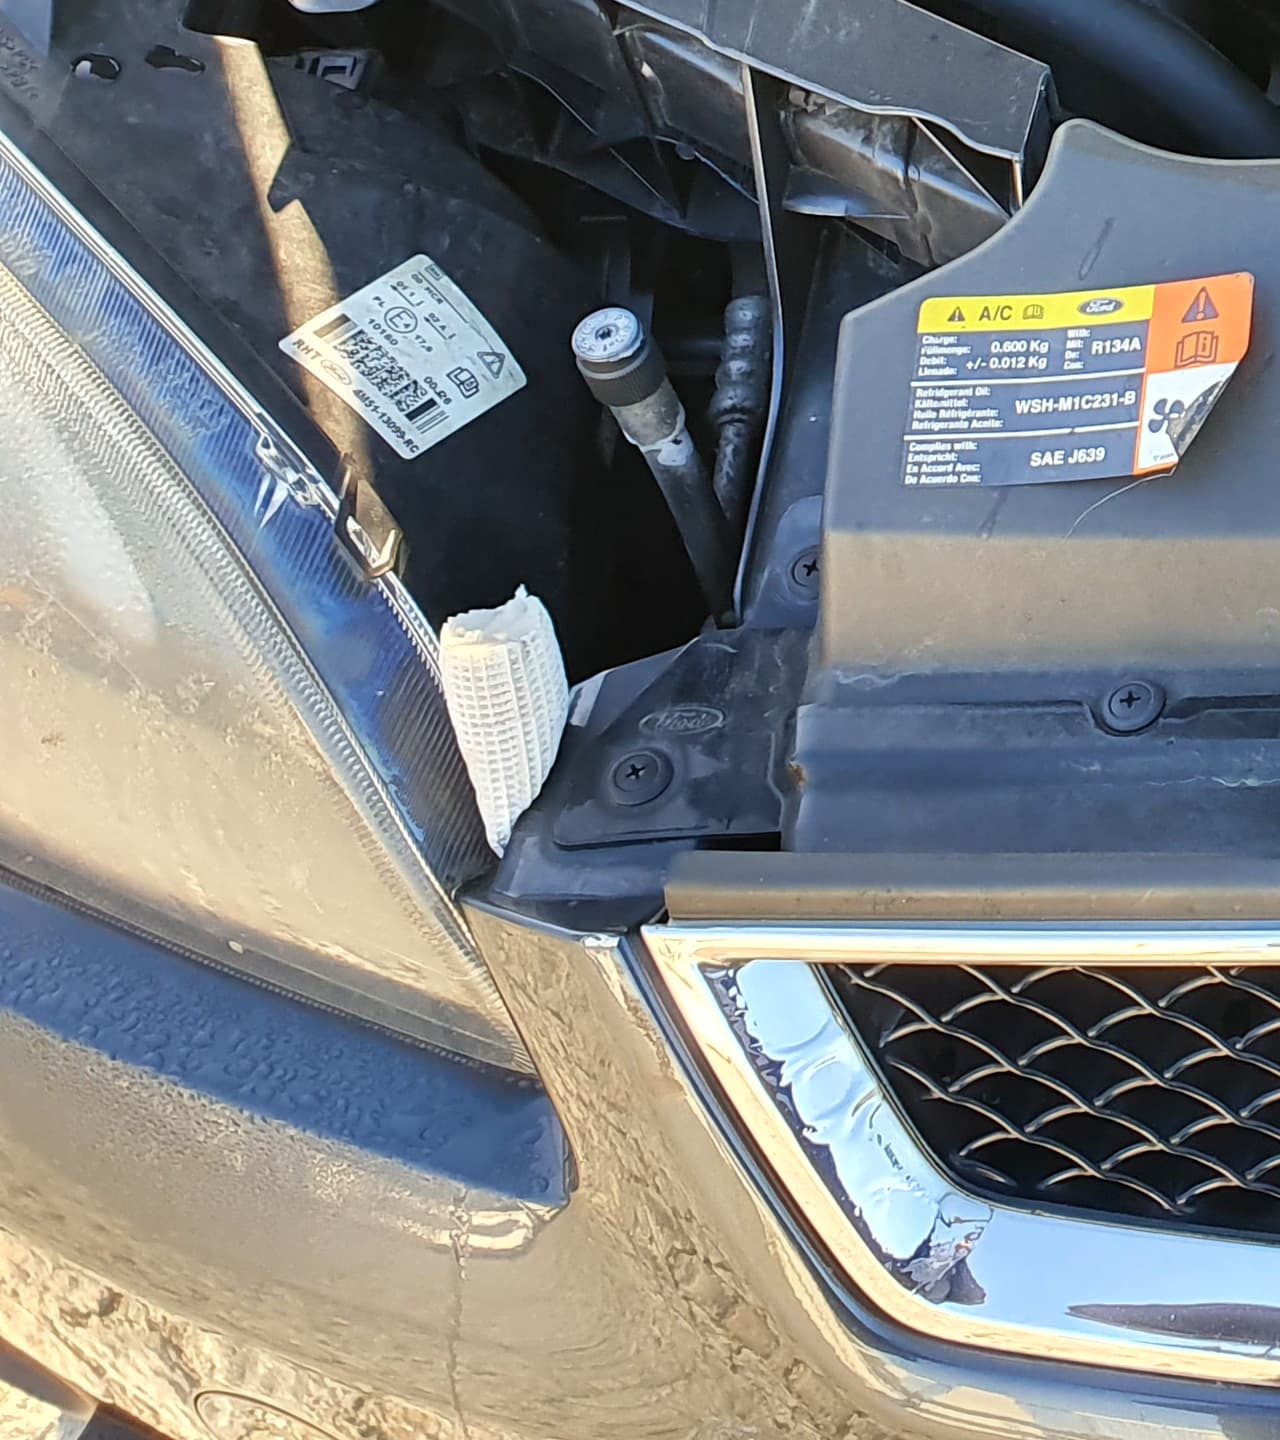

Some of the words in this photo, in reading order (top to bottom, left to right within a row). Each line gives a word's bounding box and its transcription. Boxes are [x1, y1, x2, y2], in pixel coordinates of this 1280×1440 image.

[979, 304, 1013, 322] A/C
[1082, 298, 1121, 315] Ford
[293, 338, 322, 360] RHT
[991, 341, 1027, 353] 0.600
[1030, 340, 1049, 354] Kg
[1091, 338, 1141, 355] R134A
[965, 359, 987, 370] +/-
[989, 357, 1025, 369] 0.012
[1028, 356, 1048, 370] Kg
[1015, 391, 1136, 415] WSH-M1C231-B
[1030, 449, 1064, 467] SAE
[1068, 447, 1106, 464] J639
